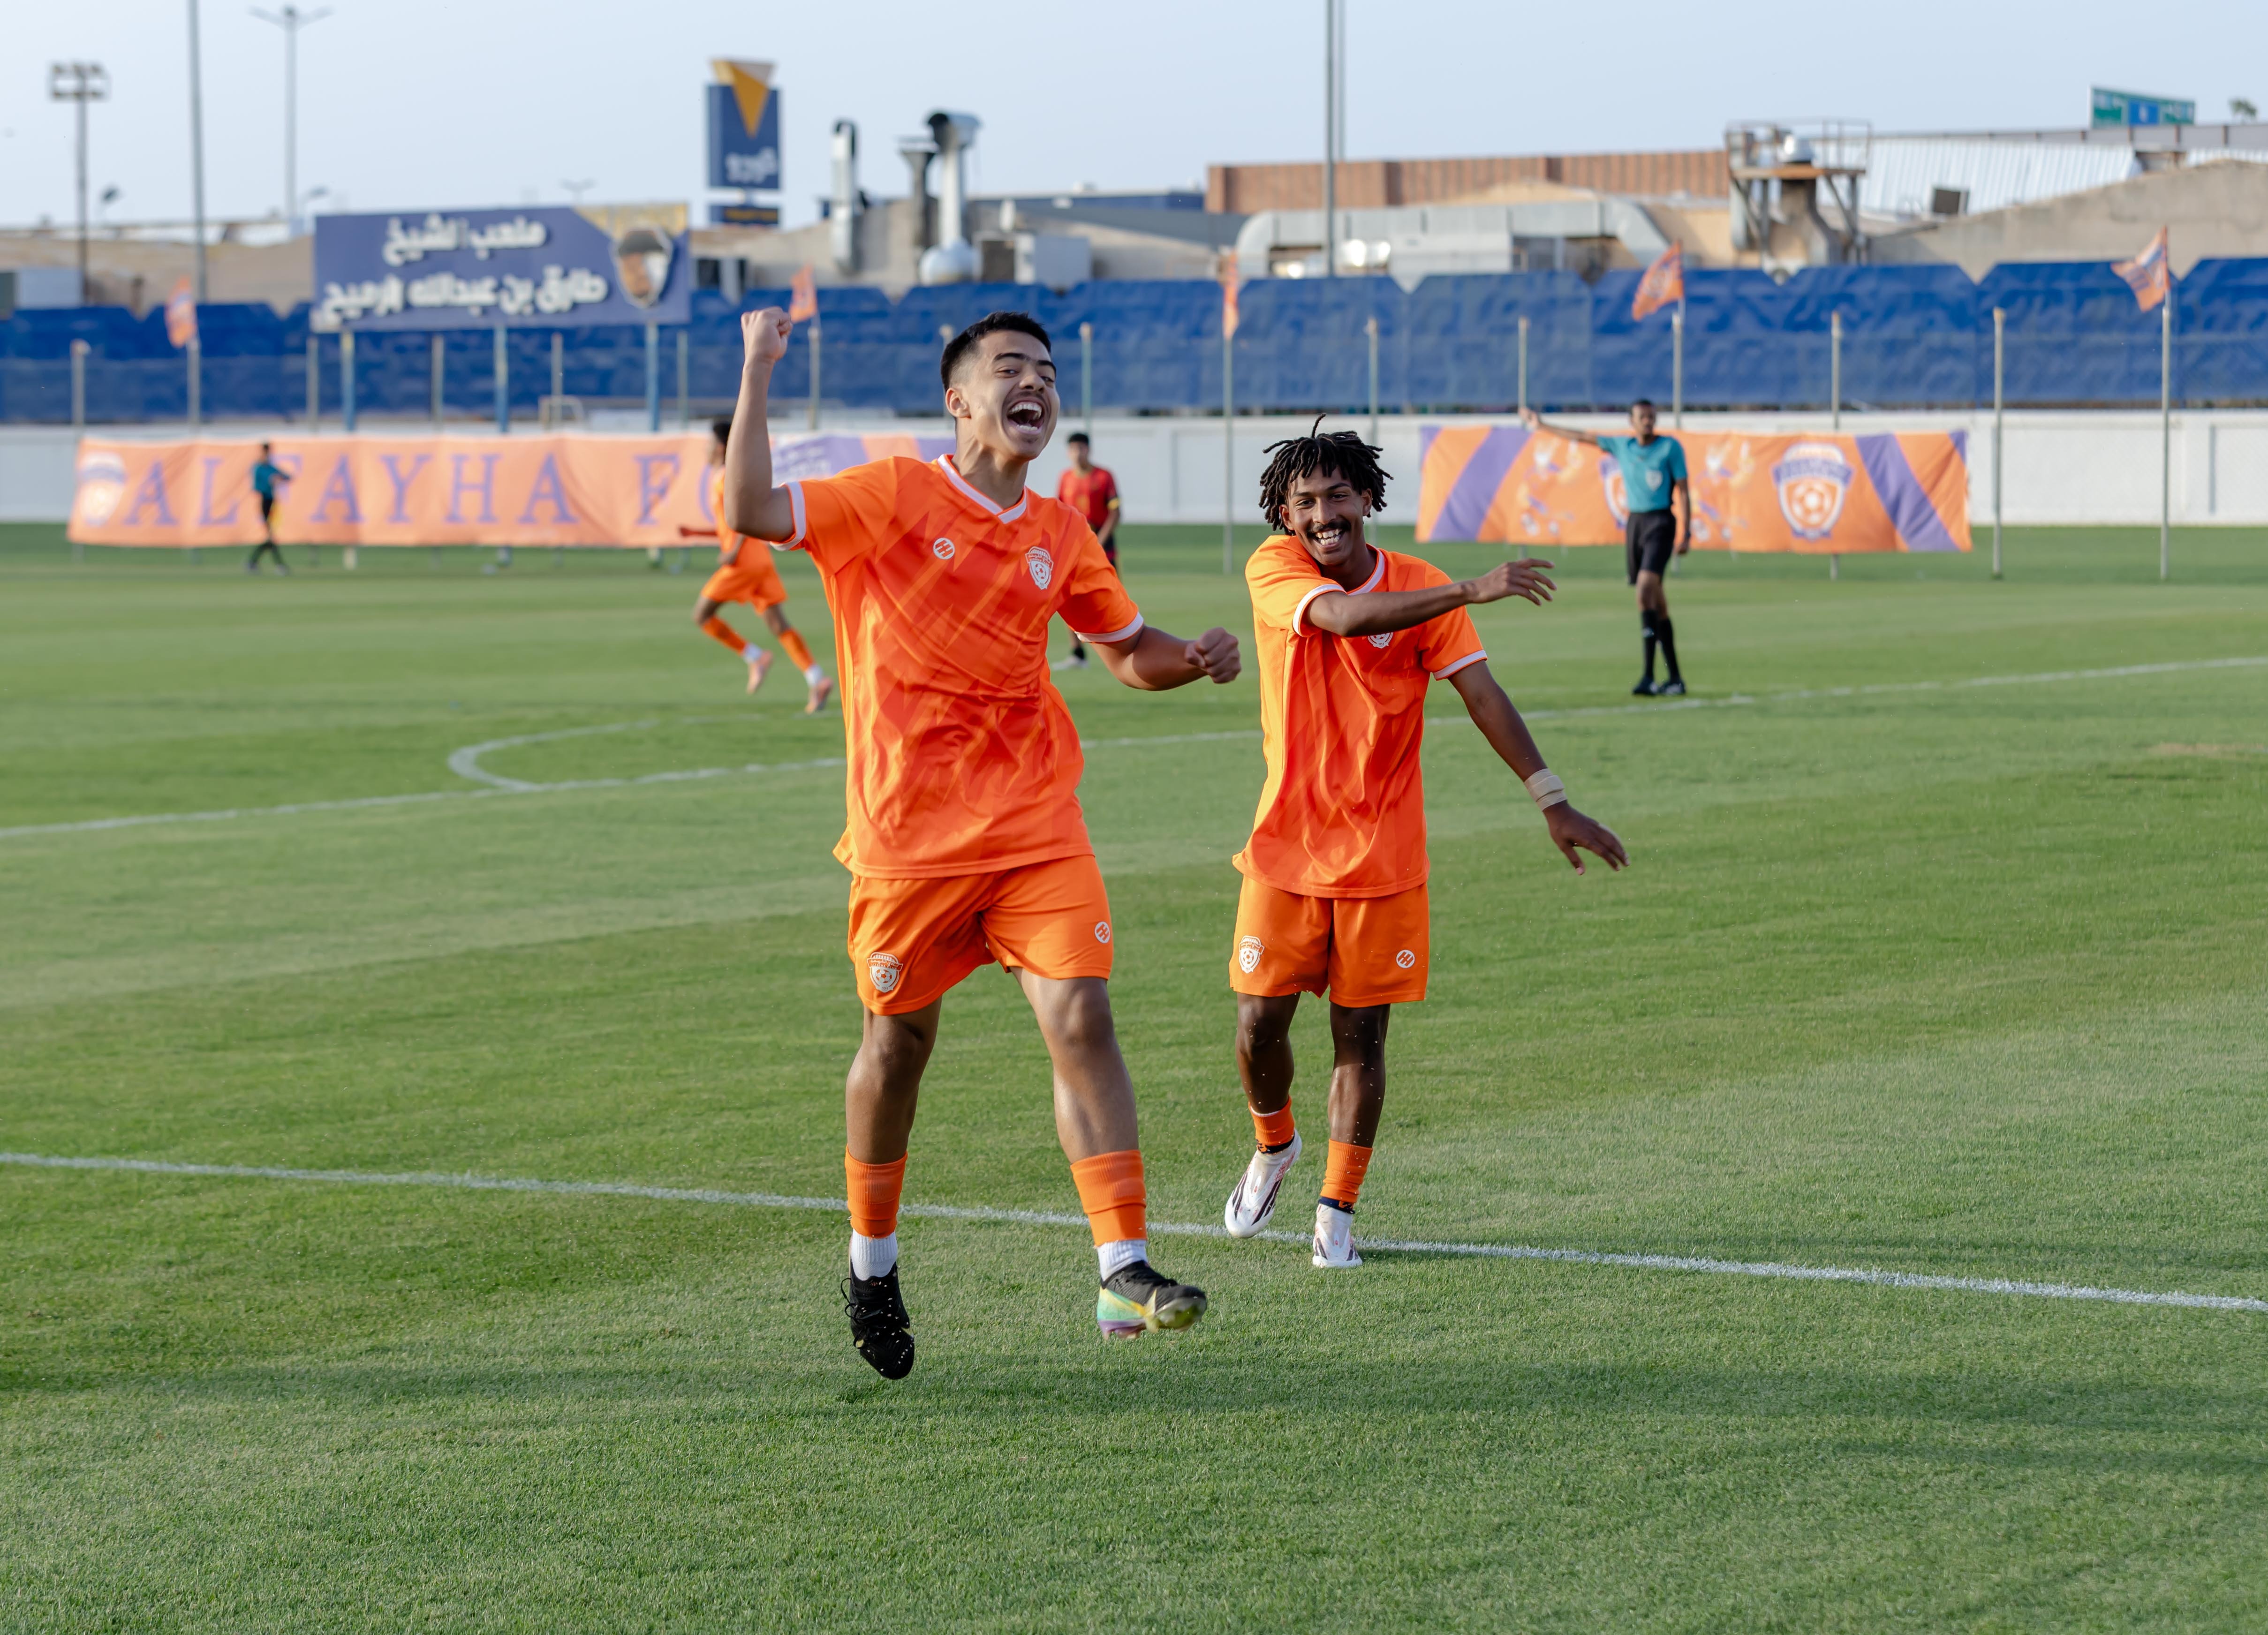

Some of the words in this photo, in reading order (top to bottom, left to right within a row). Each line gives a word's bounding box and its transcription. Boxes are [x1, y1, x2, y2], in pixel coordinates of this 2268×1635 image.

[382, 212, 469, 267] الشيخ
[469, 214, 548, 261] ملعب
[407, 270, 498, 318] عبدالله
[499, 273, 535, 315] بن
[535, 264, 609, 314] طارق
[122, 456, 241, 526] AL
